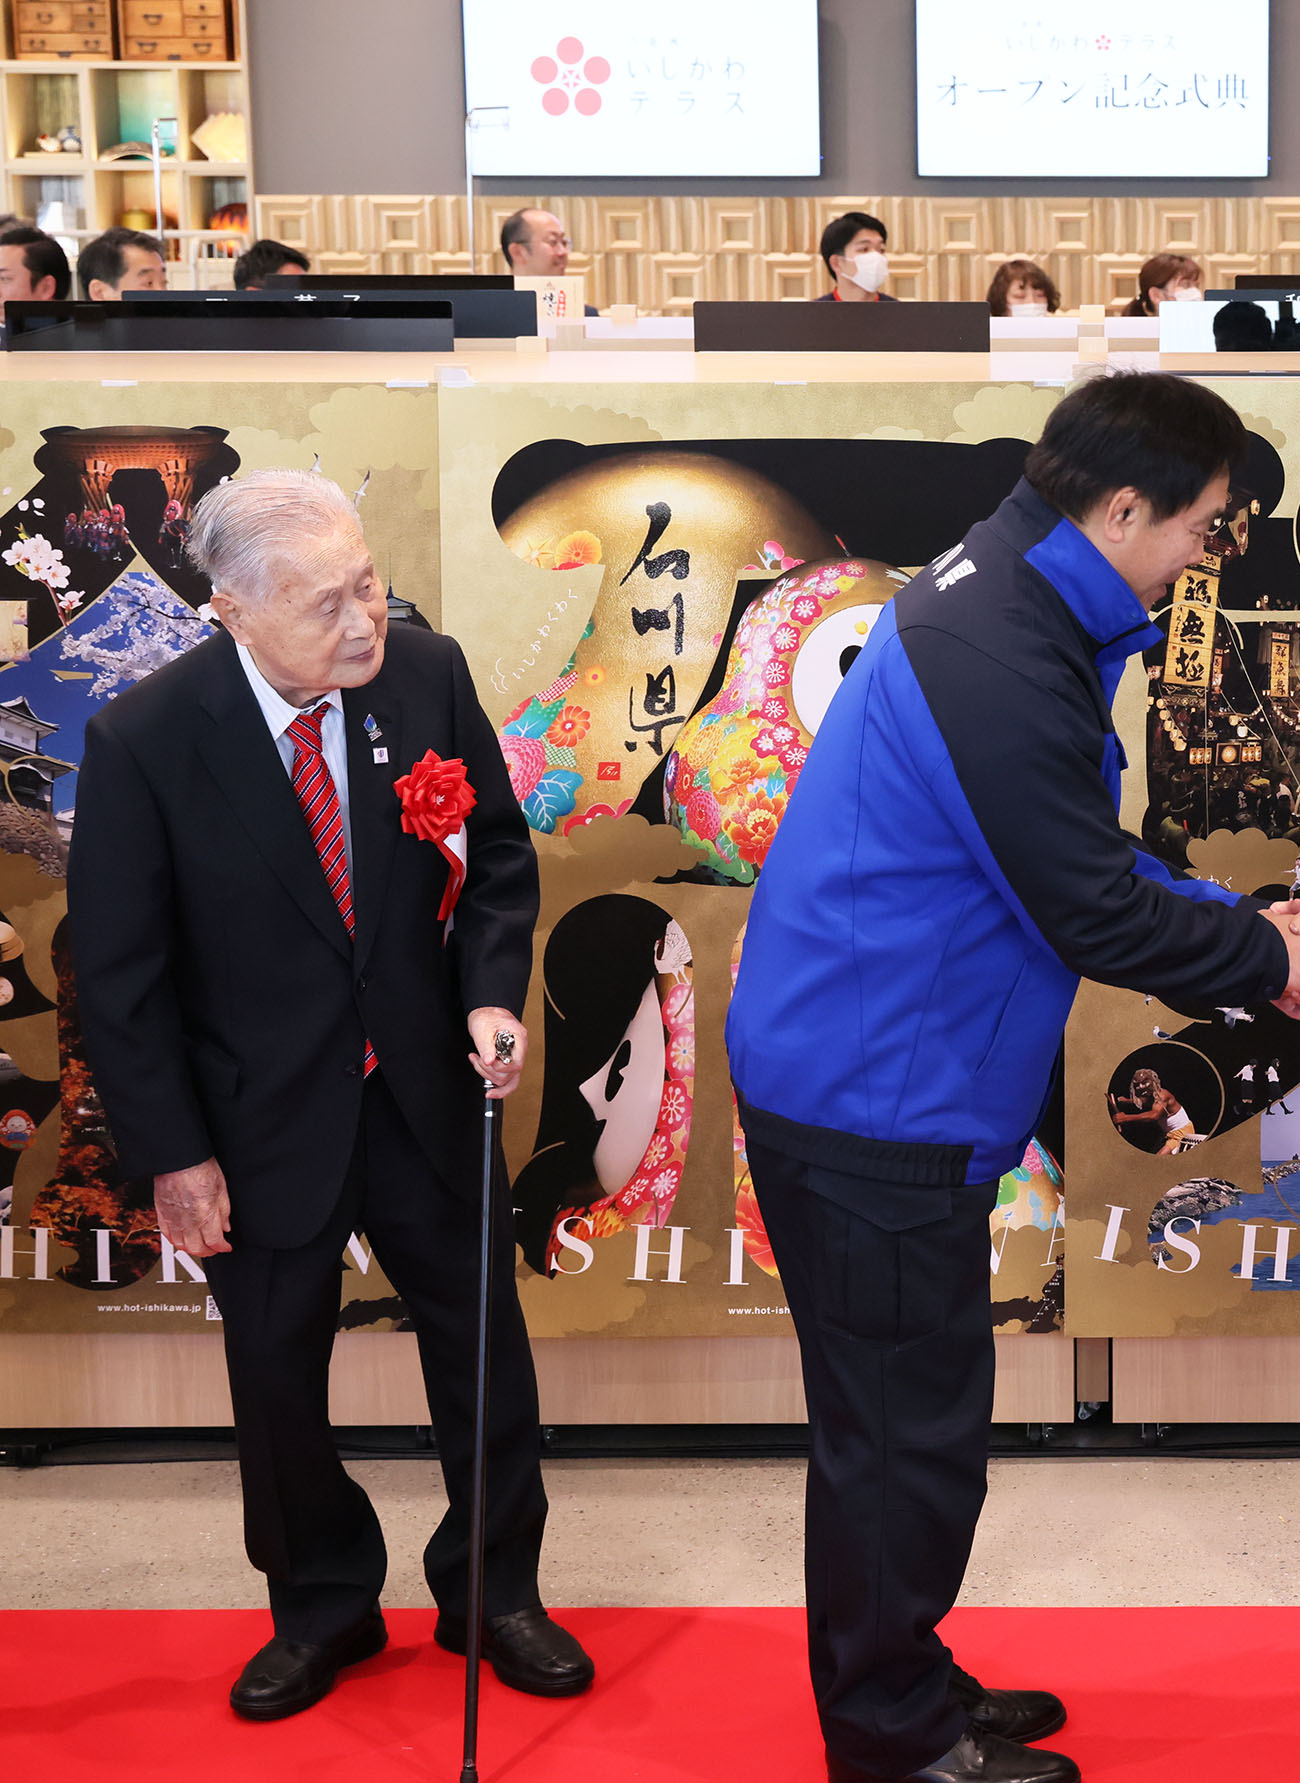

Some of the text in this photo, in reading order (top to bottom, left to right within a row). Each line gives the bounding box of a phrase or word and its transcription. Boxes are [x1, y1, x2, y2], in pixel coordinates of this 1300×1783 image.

[627, 55, 745, 81] いしかわ
[629, 91, 745, 115] テラス
[935, 72, 1249, 110] オープン記念式典
[511, 588, 579, 680] いしかわくわく
[619, 501, 691, 757] 石川県
[97, 1303, 202, 1313] www.hot-ishikawa.jp
